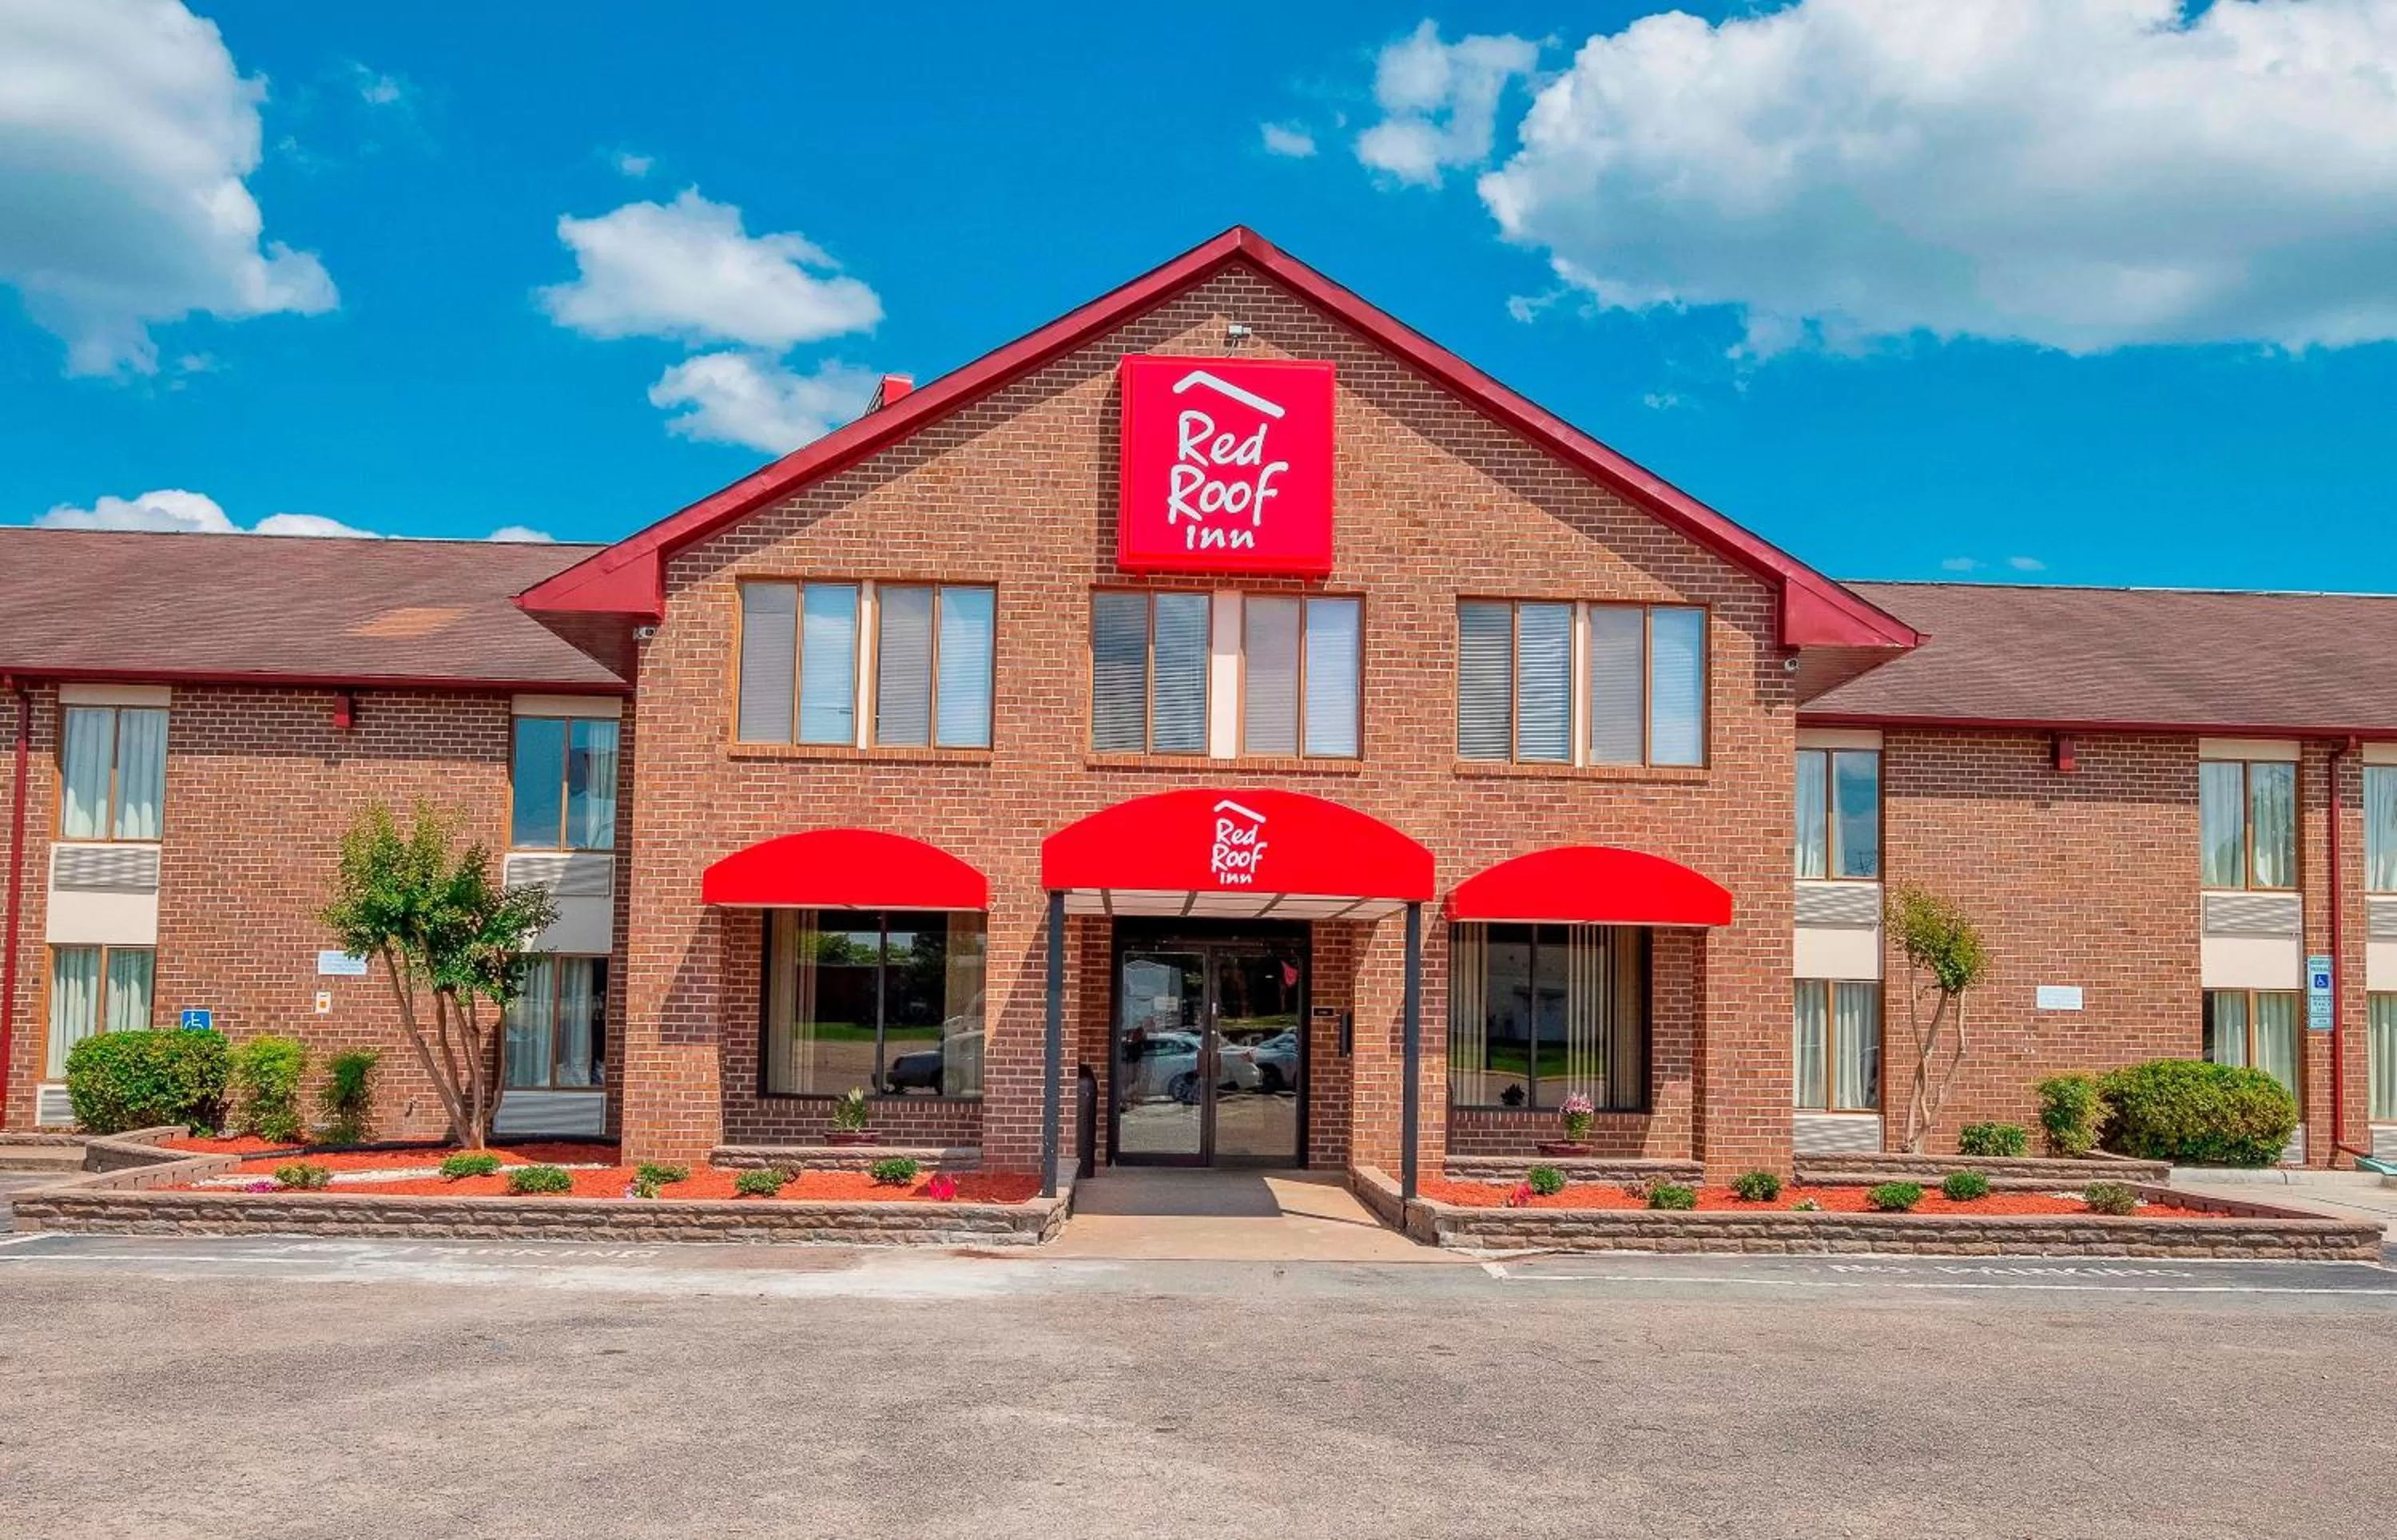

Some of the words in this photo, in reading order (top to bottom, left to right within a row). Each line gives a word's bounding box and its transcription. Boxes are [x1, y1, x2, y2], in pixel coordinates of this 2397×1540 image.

[1179, 410, 1267, 466] Red
[1167, 461, 1289, 526] Roof
[1216, 817, 1258, 845] Red
[1211, 841, 1267, 873] Roof
